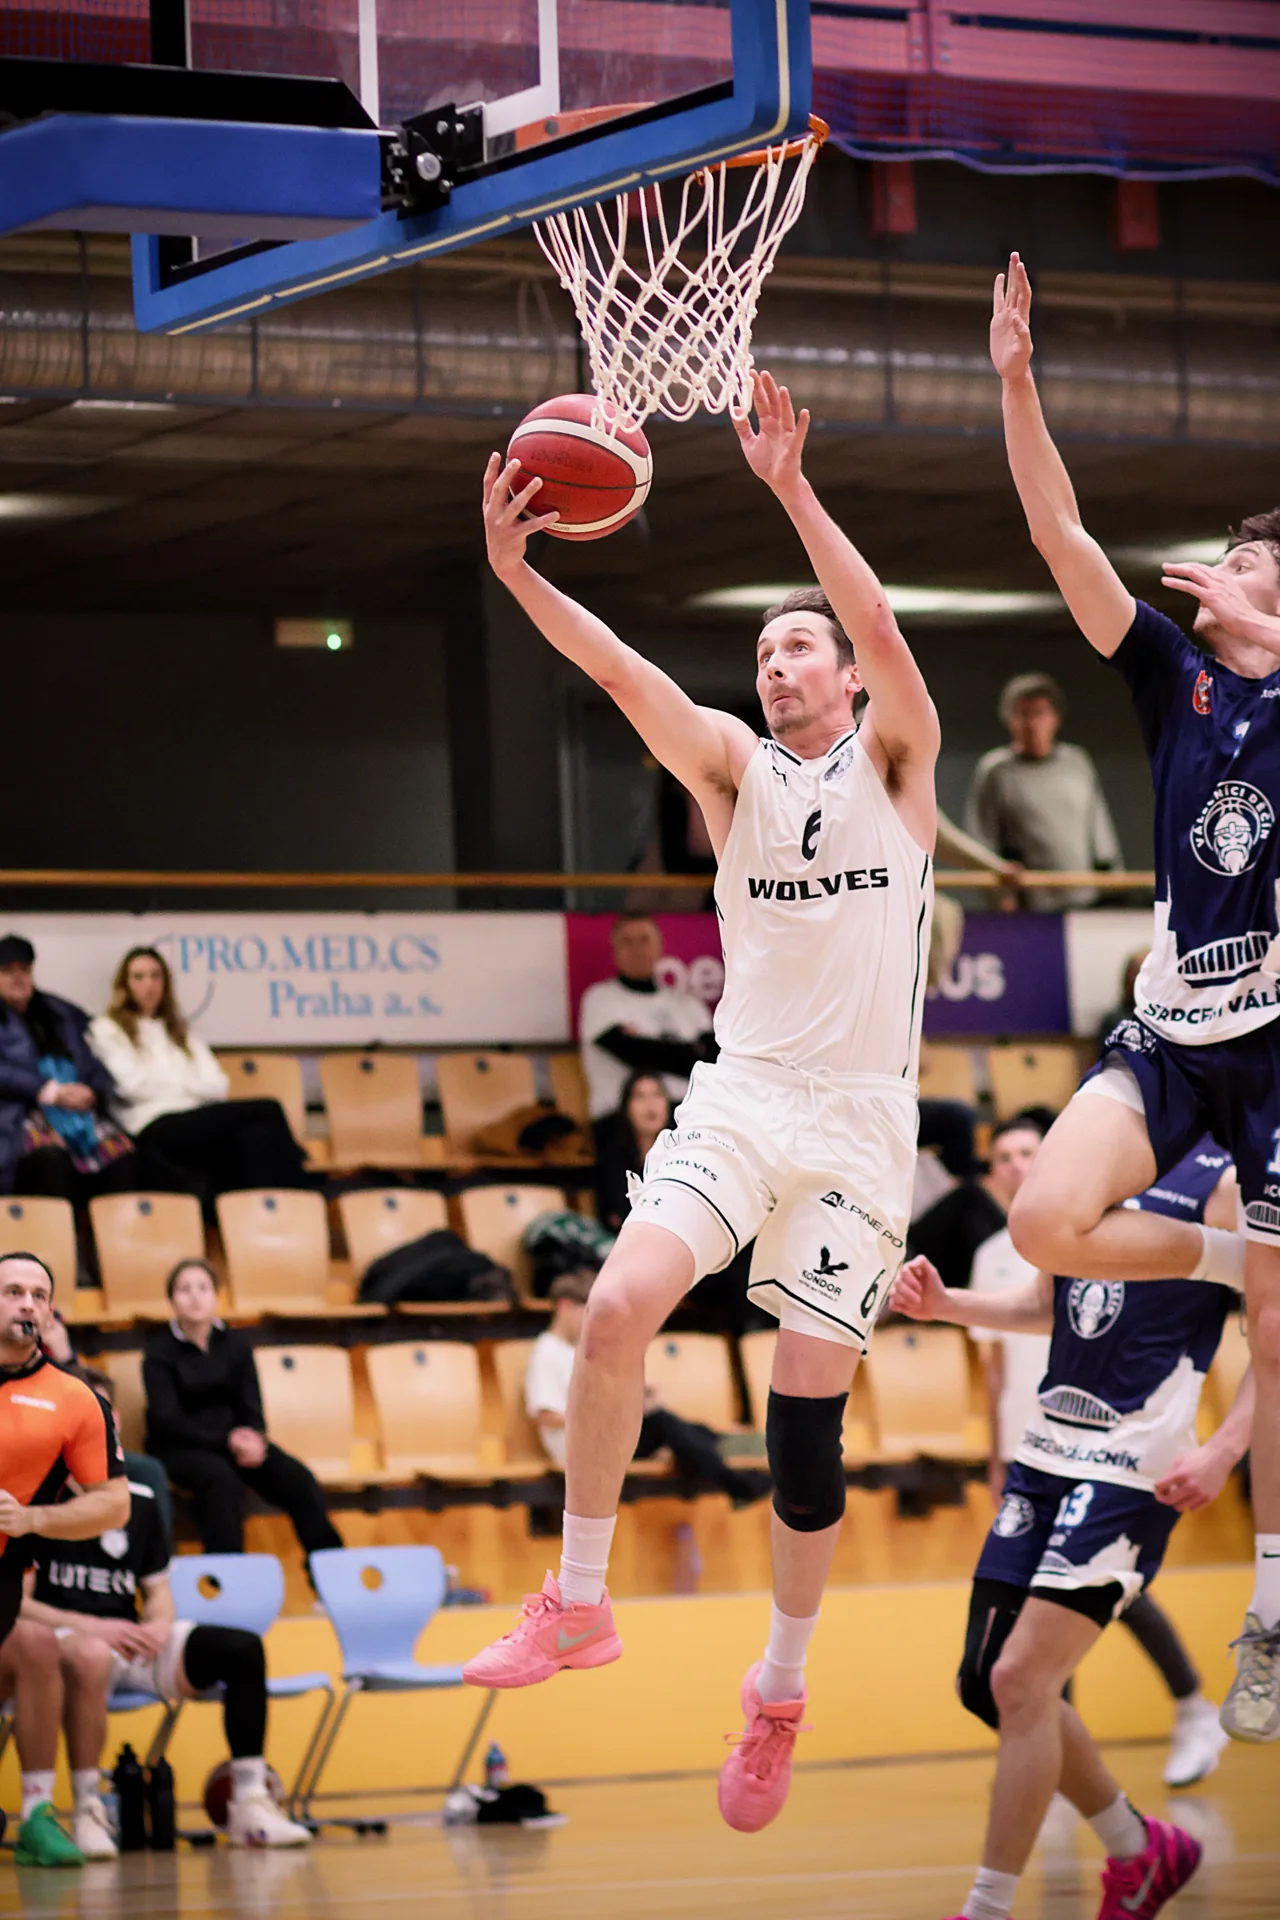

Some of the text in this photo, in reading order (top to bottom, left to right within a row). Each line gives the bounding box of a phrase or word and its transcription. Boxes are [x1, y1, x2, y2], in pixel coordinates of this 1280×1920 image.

[748, 867, 889, 901] WOLVES
[180, 933, 442, 973] PRO.MED.CS
[269, 979, 374, 1018] Praha
[687, 1130, 702, 1141] da
[820, 1190, 884, 1232] ALPINE
[801, 1269, 843, 1297] KONDOR
[859, 1268, 886, 1320] 6
[1053, 1481, 1095, 1527] 13
